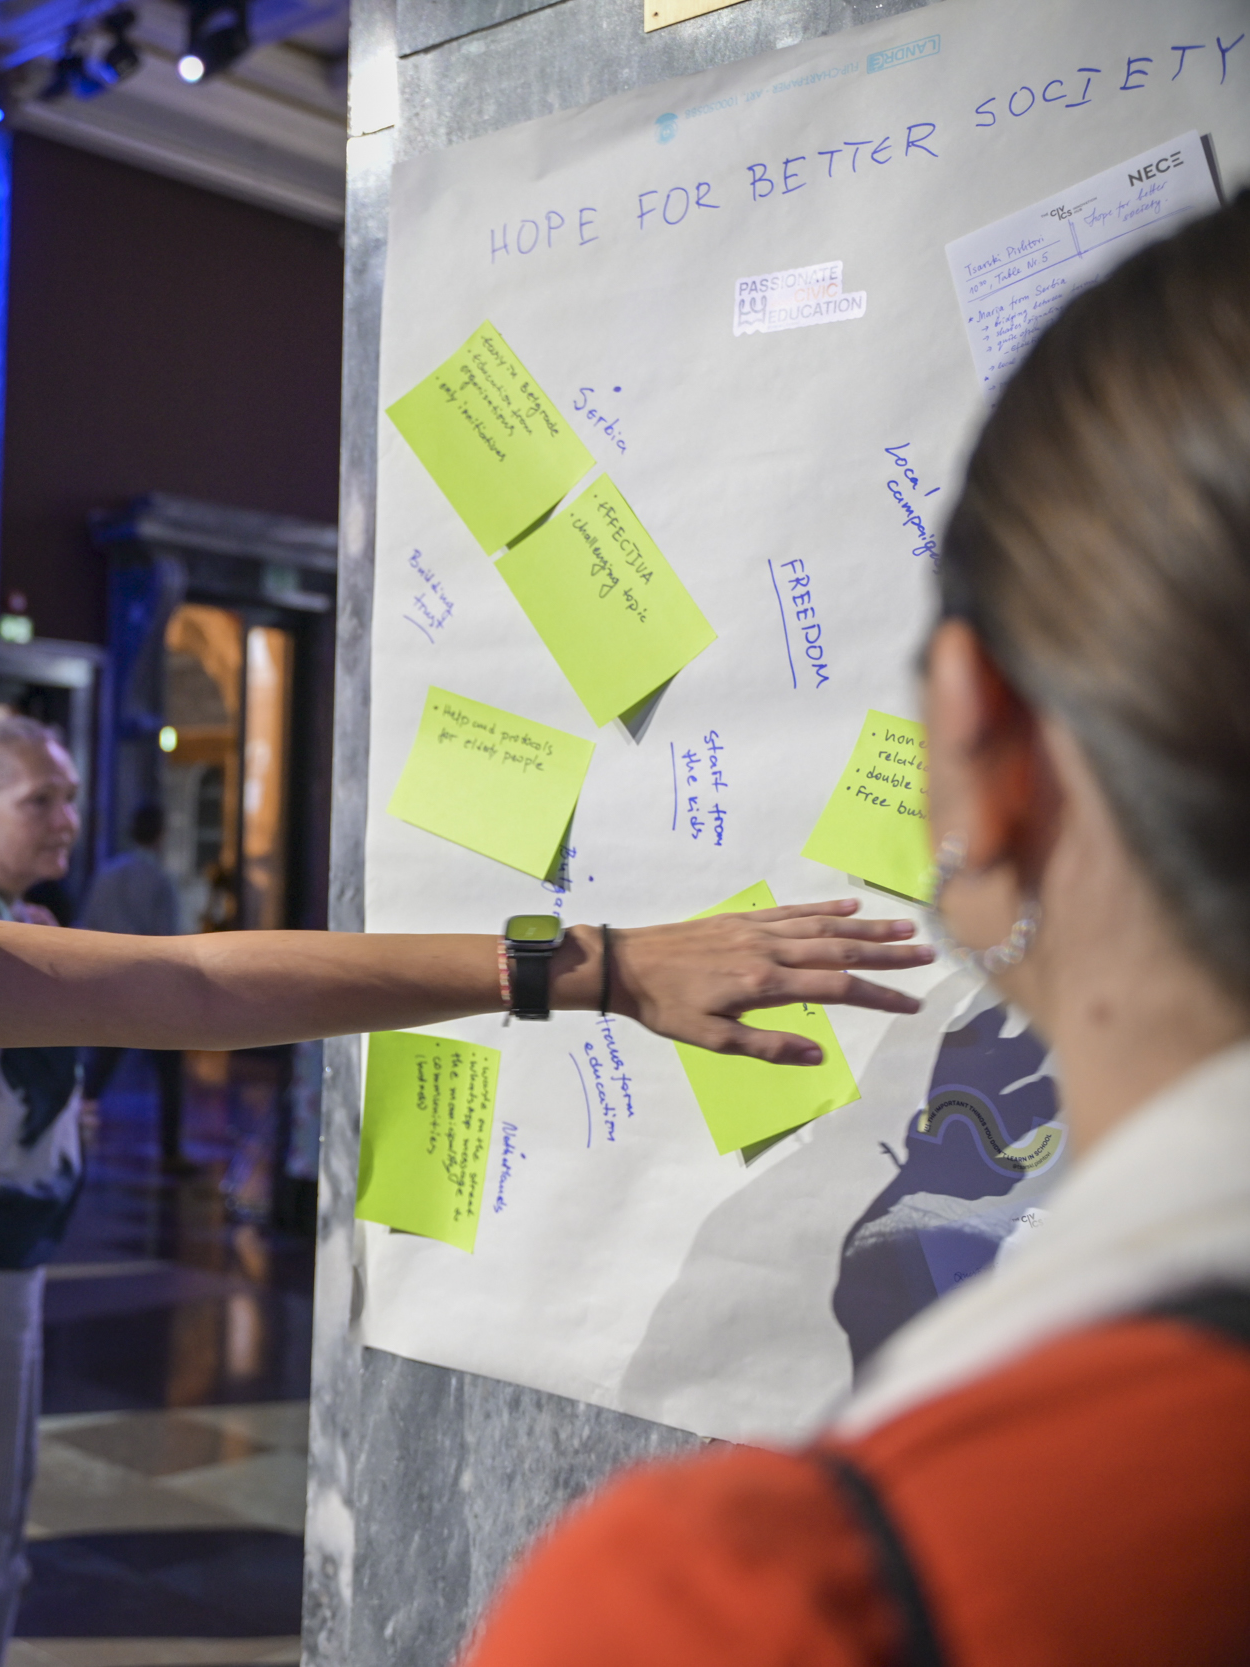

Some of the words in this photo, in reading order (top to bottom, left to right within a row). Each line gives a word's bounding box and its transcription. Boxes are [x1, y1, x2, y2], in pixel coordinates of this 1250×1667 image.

[871, 37, 939, 72] LANDRÉ
[490, 207, 599, 264] HOPE
[636, 181, 721, 230] FOR
[746, 122, 939, 201] BETTER
[975, 33, 1245, 127] SOCIETY
[1128, 151, 1184, 187] NECE
[1116, 200, 1130, 218] for
[1137, 181, 1168, 201] better
[739, 265, 839, 296] PASSIONATE
[994, 266, 1022, 284] Table
[1042, 251, 1048, 262] 5
[768, 295, 863, 325] EDUCATION
[794, 282, 839, 303] CIVIC
[1009, 295, 1030, 310] from
[1035, 277, 1067, 297] Serbia
[573, 387, 627, 455] Serbia
[622, 587, 647, 623] topic
[779, 558, 830, 689] FREEDOM
[501, 750, 544, 774] people
[681, 748, 701, 787] the
[866, 765, 912, 790] double
[707, 803, 727, 846] from
[449, 1052, 463, 1080] the
[928, 1112, 937, 1124] THE
[934, 1100, 969, 1115] IMPORTANT
[969, 1105, 987, 1128] THINGS
[984, 1126, 993, 1140] YOU
[1006, 1153, 1027, 1163] LEARN
[1027, 1153, 1035, 1162] IN
[1033, 1133, 1052, 1158] SCHOOL
